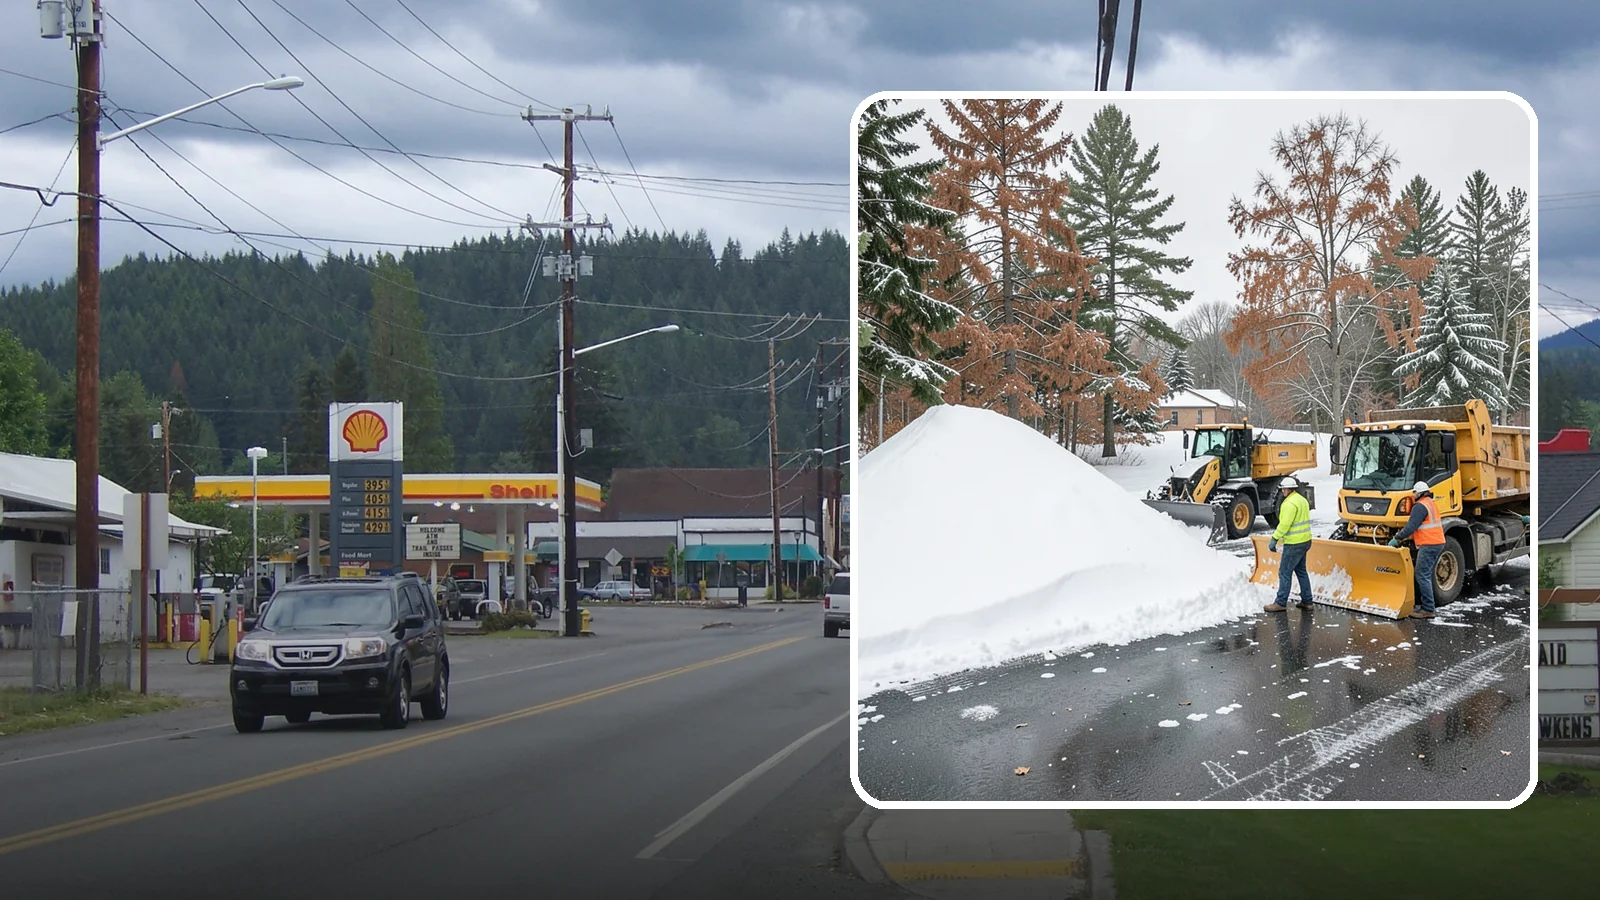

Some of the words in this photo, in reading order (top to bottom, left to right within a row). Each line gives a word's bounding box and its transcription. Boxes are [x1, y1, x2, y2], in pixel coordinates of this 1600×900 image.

[366, 480, 383, 490] 395
[490, 484, 547, 499] Shell
[366, 494, 383, 504] 405
[366, 508, 383, 518] 415
[366, 522, 383, 532] 429
[1539, 643, 1567, 665] AID
